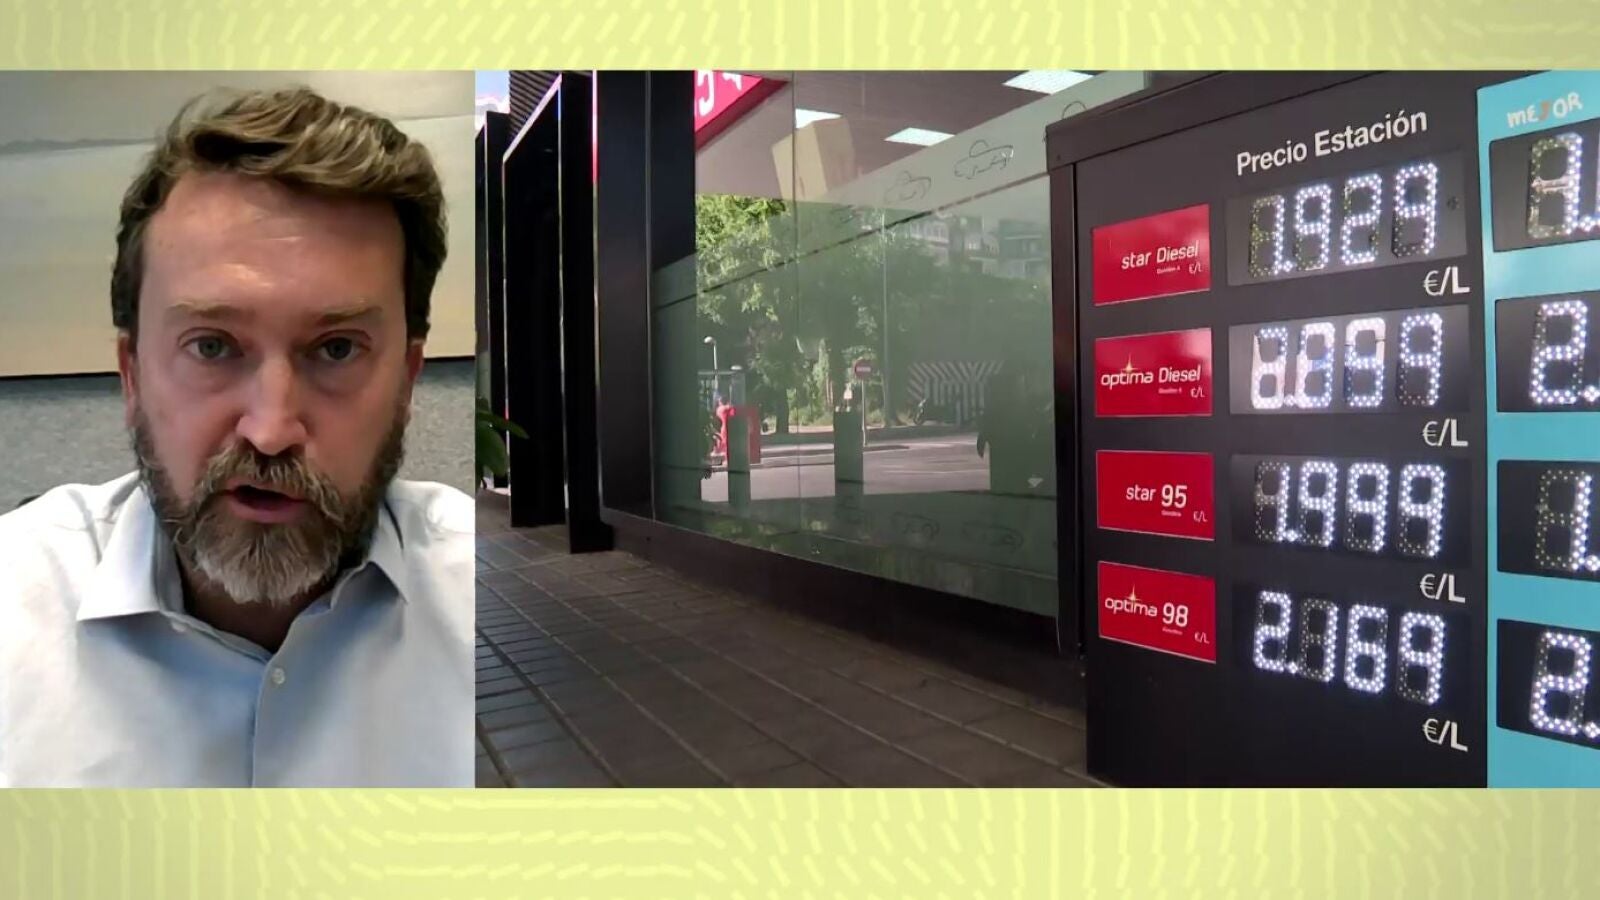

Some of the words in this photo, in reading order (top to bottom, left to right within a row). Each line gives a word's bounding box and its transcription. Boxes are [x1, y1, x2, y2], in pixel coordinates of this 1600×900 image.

[1237, 140, 1308, 176] Precio
[1314, 110, 1427, 157] Estación
[1250, 162, 1438, 275] 1.929
[1121, 252, 1152, 270] star
[1156, 239, 1199, 264] Diesel
[1423, 266, 1470, 296] €/L
[1101, 371, 1154, 390] optima
[1158, 364, 1201, 383] Diesel
[1422, 418, 1469, 447] €/L
[1125, 484, 1157, 502] star
[1161, 484, 1188, 508] 95
[1255, 460, 1446, 558] 1.999
[1419, 573, 1466, 604] €/L
[1104, 597, 1158, 617] optima
[1162, 602, 1189, 627] 98
[1252, 590, 1445, 705] 2.169
[1422, 718, 1469, 752] €/L
